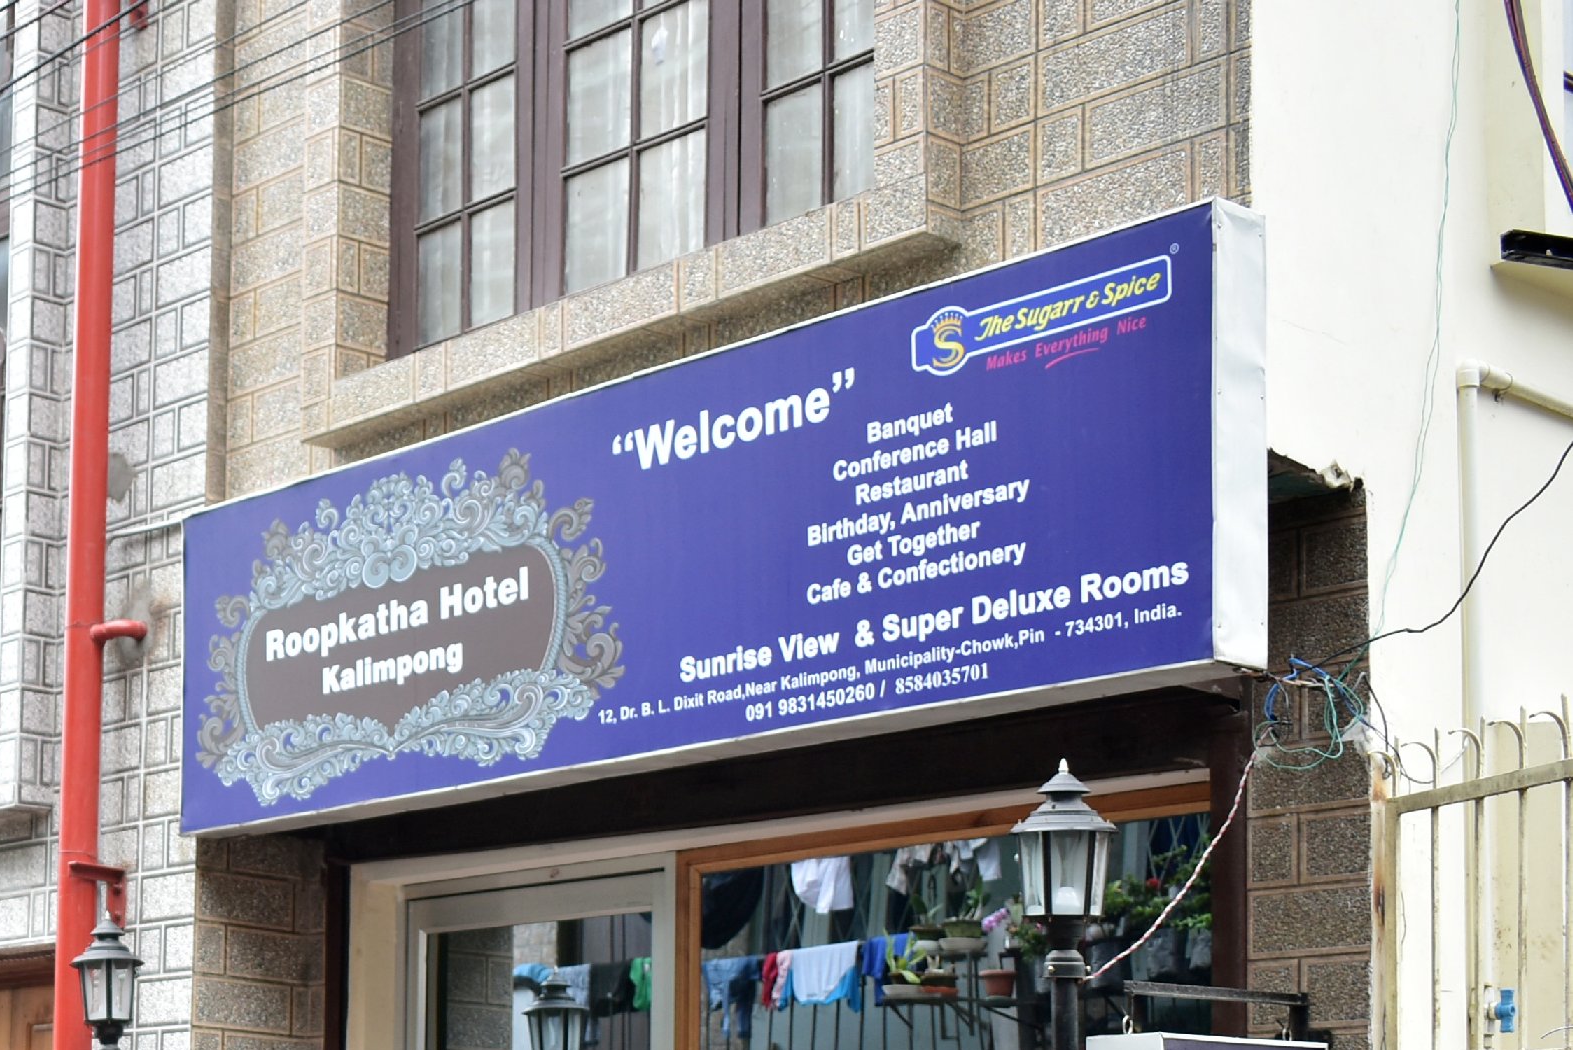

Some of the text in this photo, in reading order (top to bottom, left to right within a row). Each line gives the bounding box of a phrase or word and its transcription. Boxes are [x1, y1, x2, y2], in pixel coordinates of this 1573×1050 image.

[974, 272, 1162, 341] The Sugarr & Spice
[986, 317, 1147, 371] Makes Everything Nice
[833, 420, 997, 481] Conference Hall
[866, 402, 954, 444] Banquet
[807, 479, 1030, 547] Birthday, Anniversary
[855, 459, 969, 506] Restaurant
[807, 542, 1027, 605] Cafe & Confectionery
[847, 520, 981, 566] Get Together
[265, 566, 529, 662] Roopkatha Hotel
[679, 562, 1190, 683] Sunrise View & Super Deluxe Rooms
[322, 642, 463, 695] Kalimpong
[598, 709, 618, 724] 12,
[620, 705, 638, 721] Dr.
[641, 702, 655, 717] B.
[658, 699, 670, 714] L.
[673, 693, 704, 711] Dixit
[780, 665, 861, 690] Kalimpong,
[1065, 611, 1129, 637] 734301,
[1134, 603, 1182, 624] India.
[745, 701, 773, 722] 091
[778, 682, 875, 716] 9831450260
[895, 662, 988, 694] 8584035701
